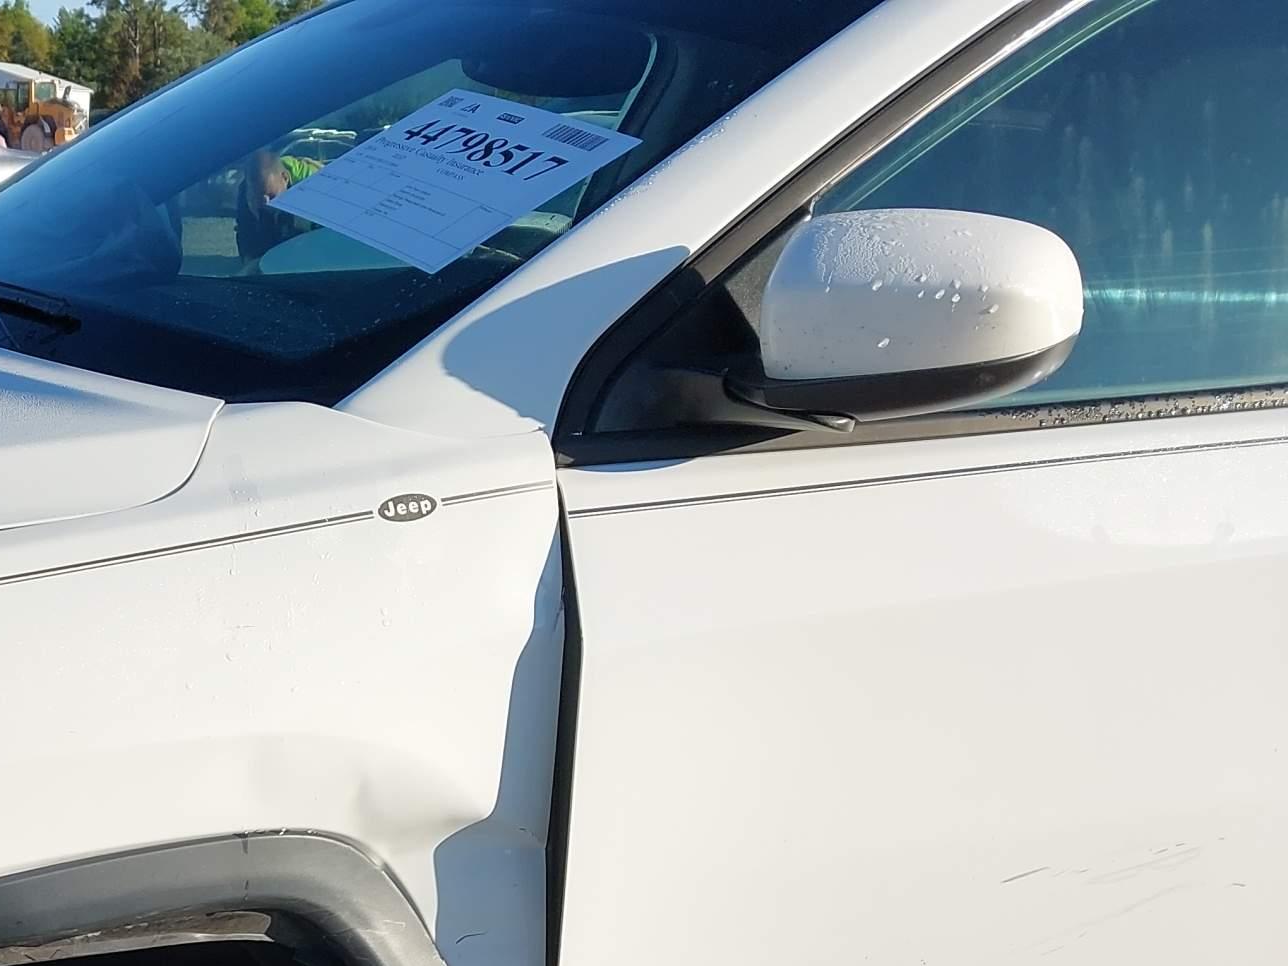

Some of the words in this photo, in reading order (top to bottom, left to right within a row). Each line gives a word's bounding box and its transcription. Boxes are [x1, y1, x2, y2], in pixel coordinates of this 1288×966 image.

[403, 119, 569, 181] 44798517
[446, 158, 485, 177] Insurance
[383, 499, 432, 518] Jeep
